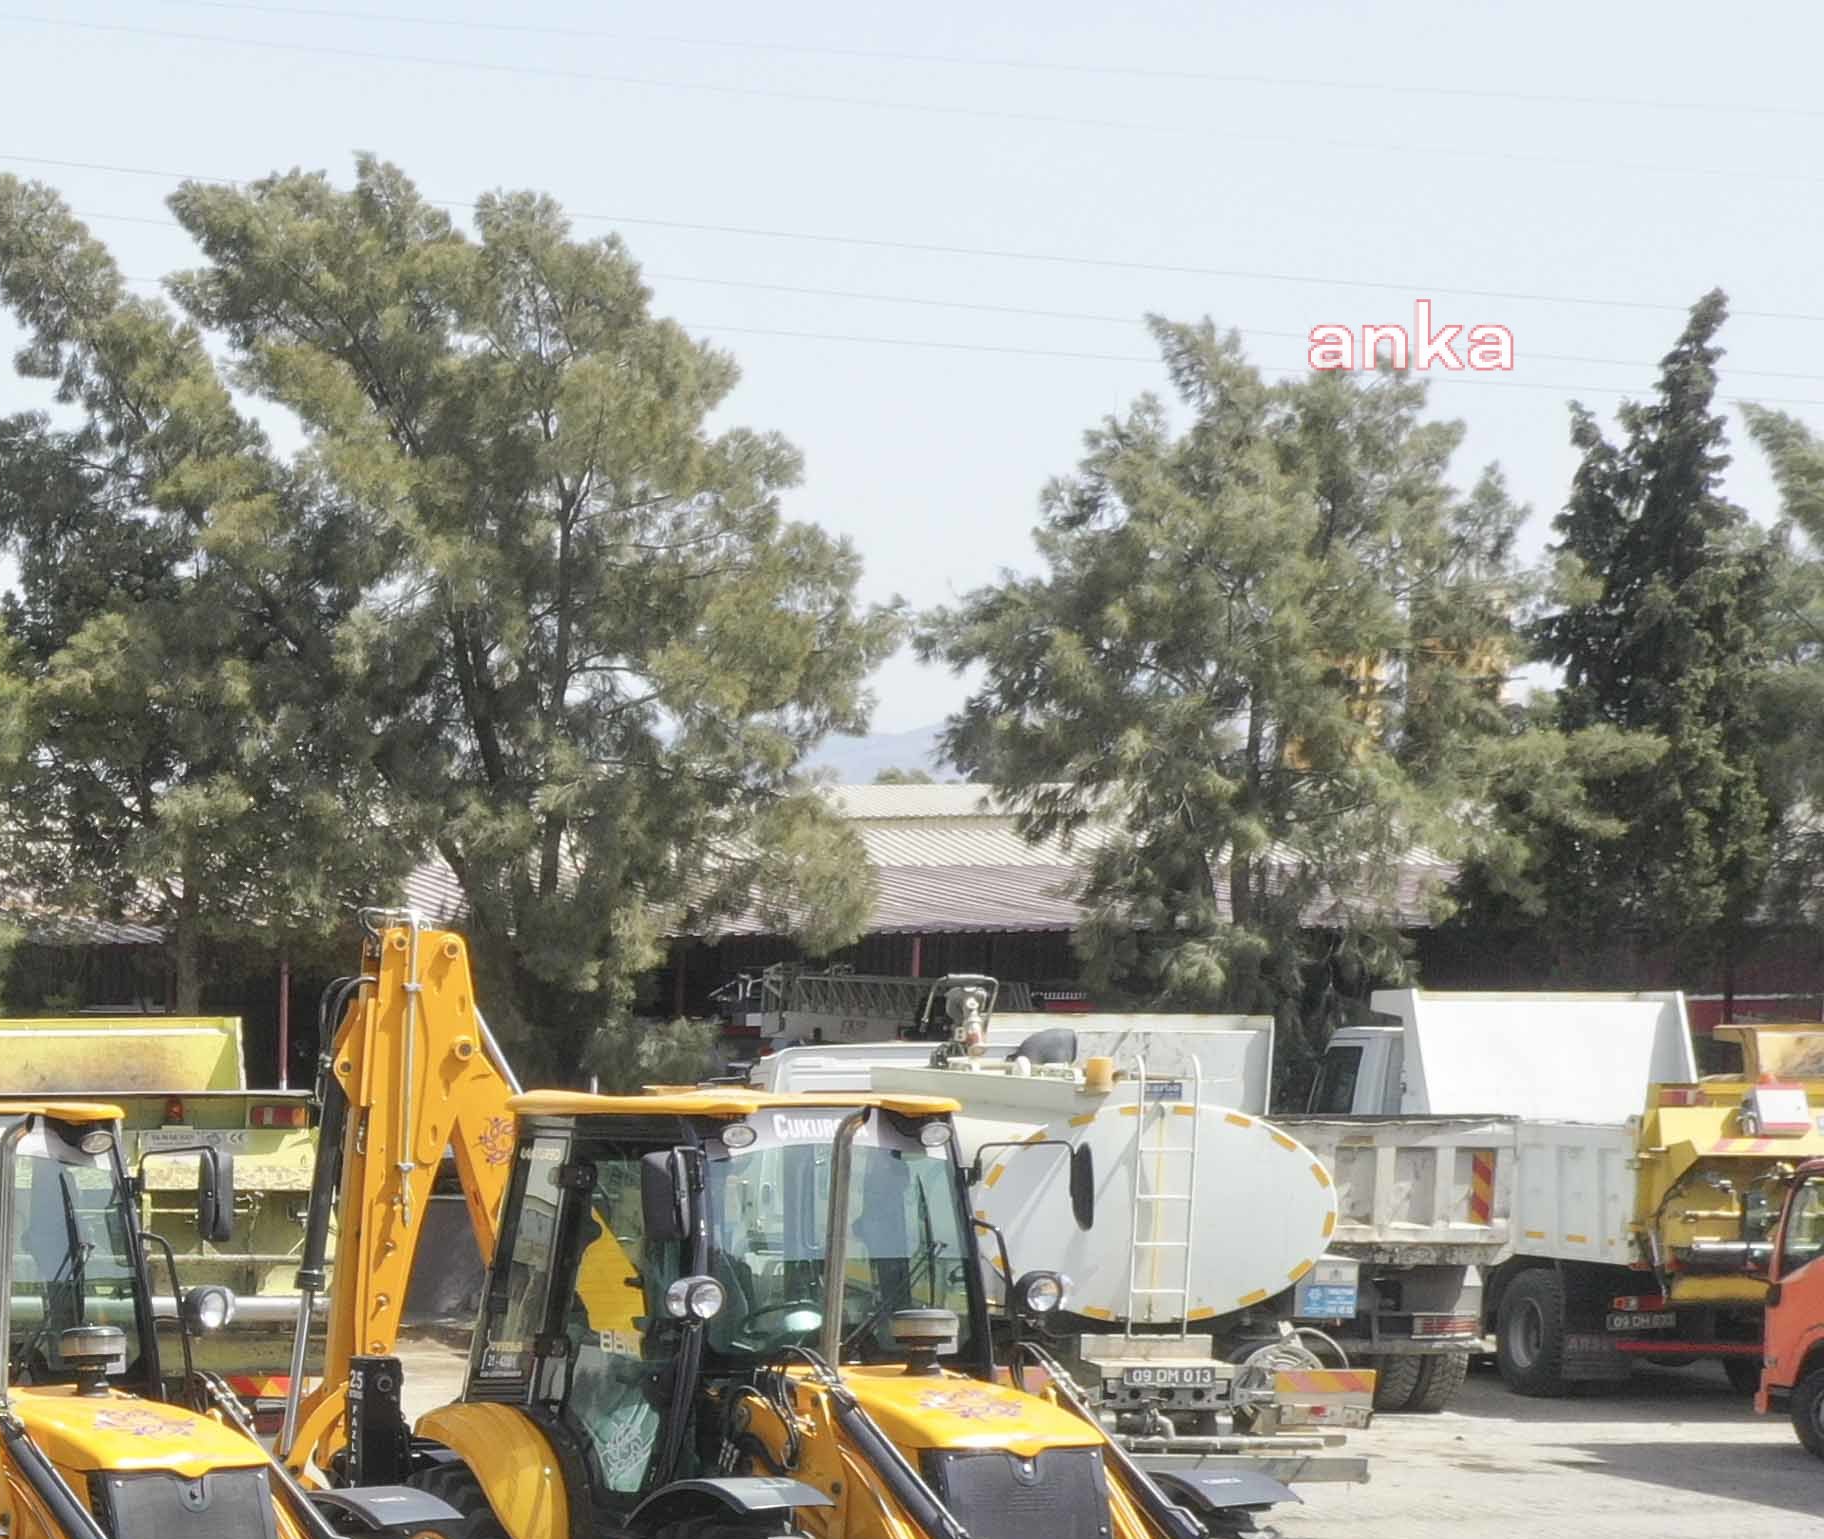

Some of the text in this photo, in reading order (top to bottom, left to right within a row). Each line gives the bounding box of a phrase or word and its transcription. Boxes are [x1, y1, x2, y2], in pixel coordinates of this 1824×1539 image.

[351, 1369, 364, 1390] 25
[1132, 1369, 1153, 1383] 09
[1183, 1369, 1212, 1384] 013
[350, 1405, 358, 1465] FAZLA
